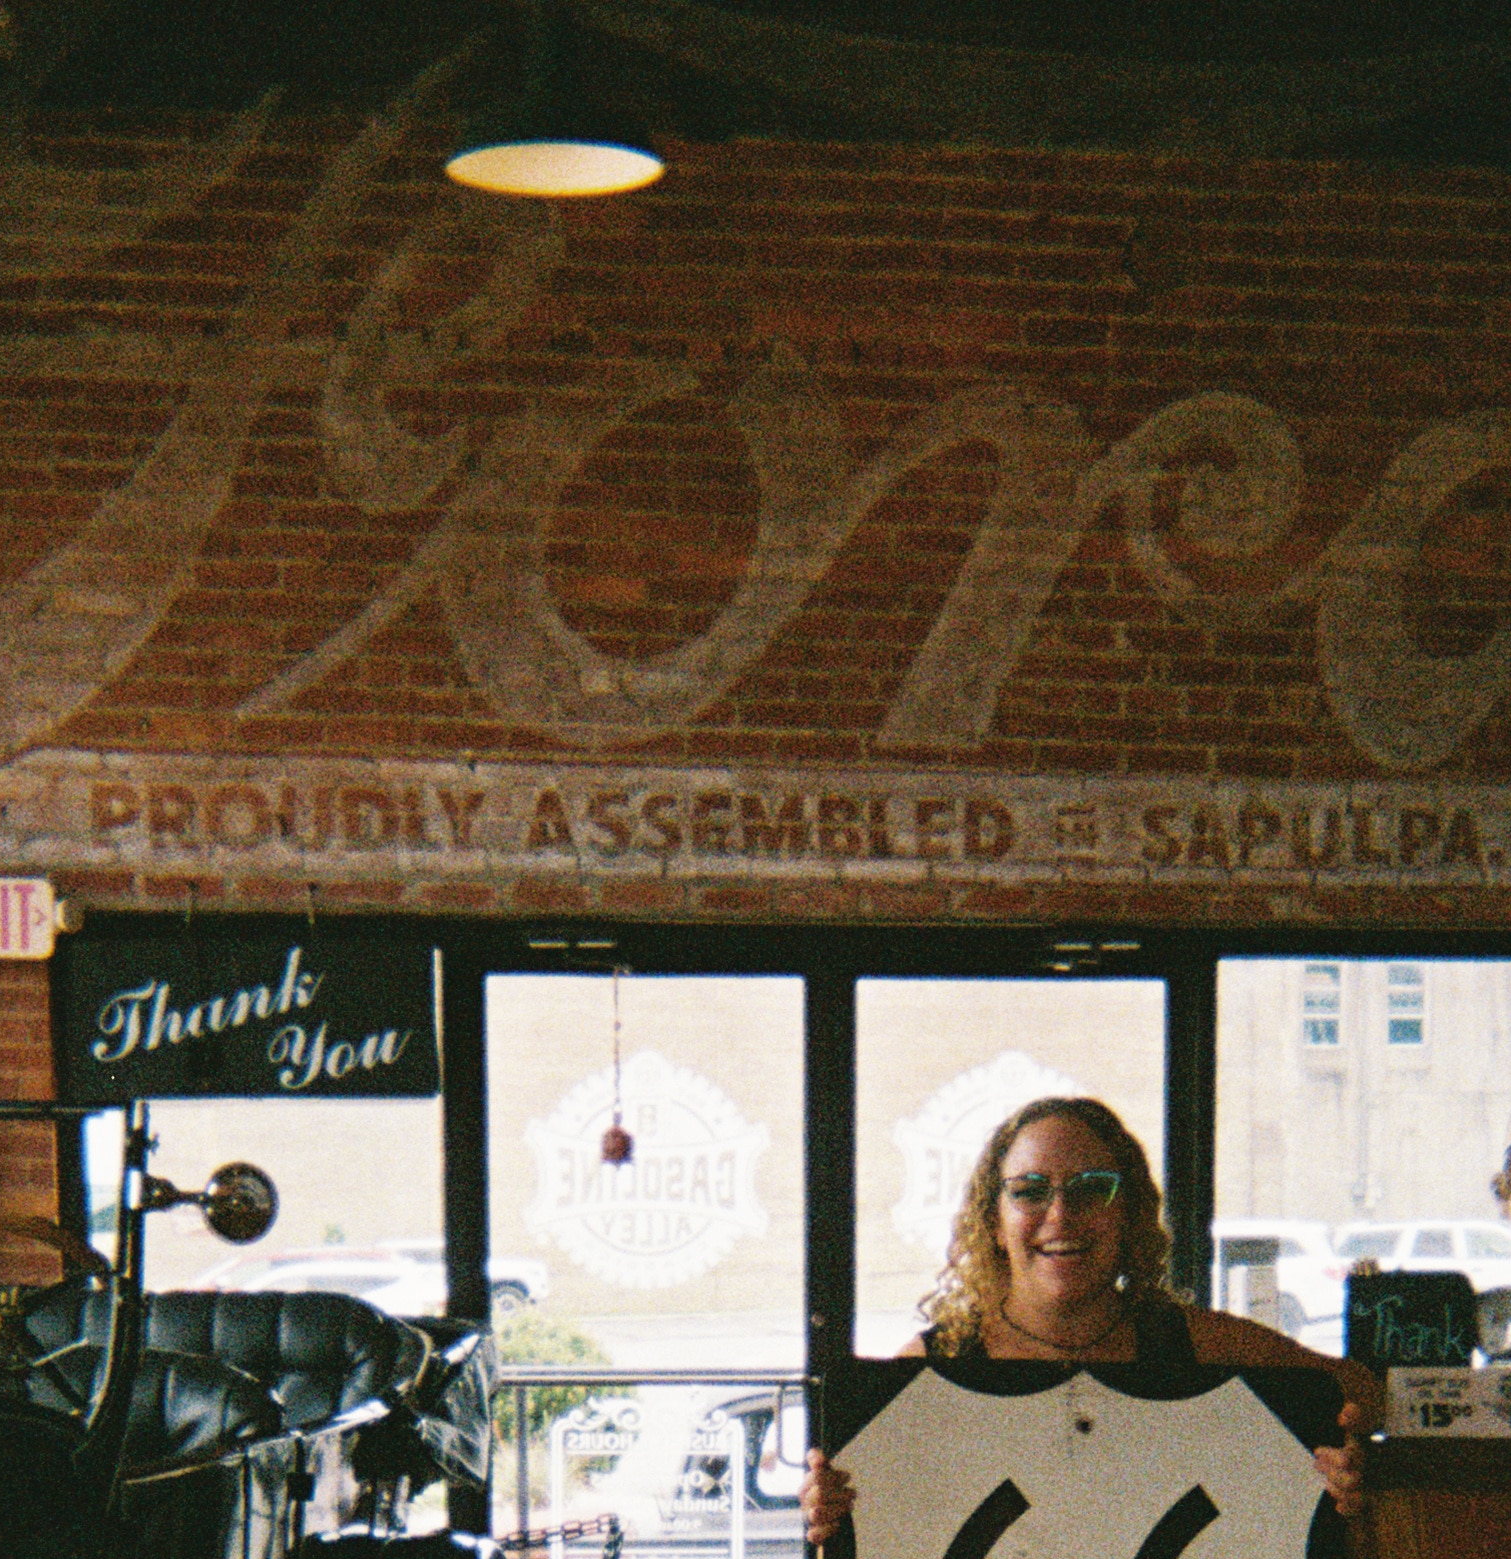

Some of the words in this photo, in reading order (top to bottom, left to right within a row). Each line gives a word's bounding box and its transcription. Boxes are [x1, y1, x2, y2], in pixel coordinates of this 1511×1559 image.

[90, 782, 490, 851] PROUDLY
[522, 786, 1017, 861] ASSEMBLED
[91, 945, 326, 1065] Thank
[266, 1022, 416, 1089] You
[1353, 1292, 1468, 1361] Thank
